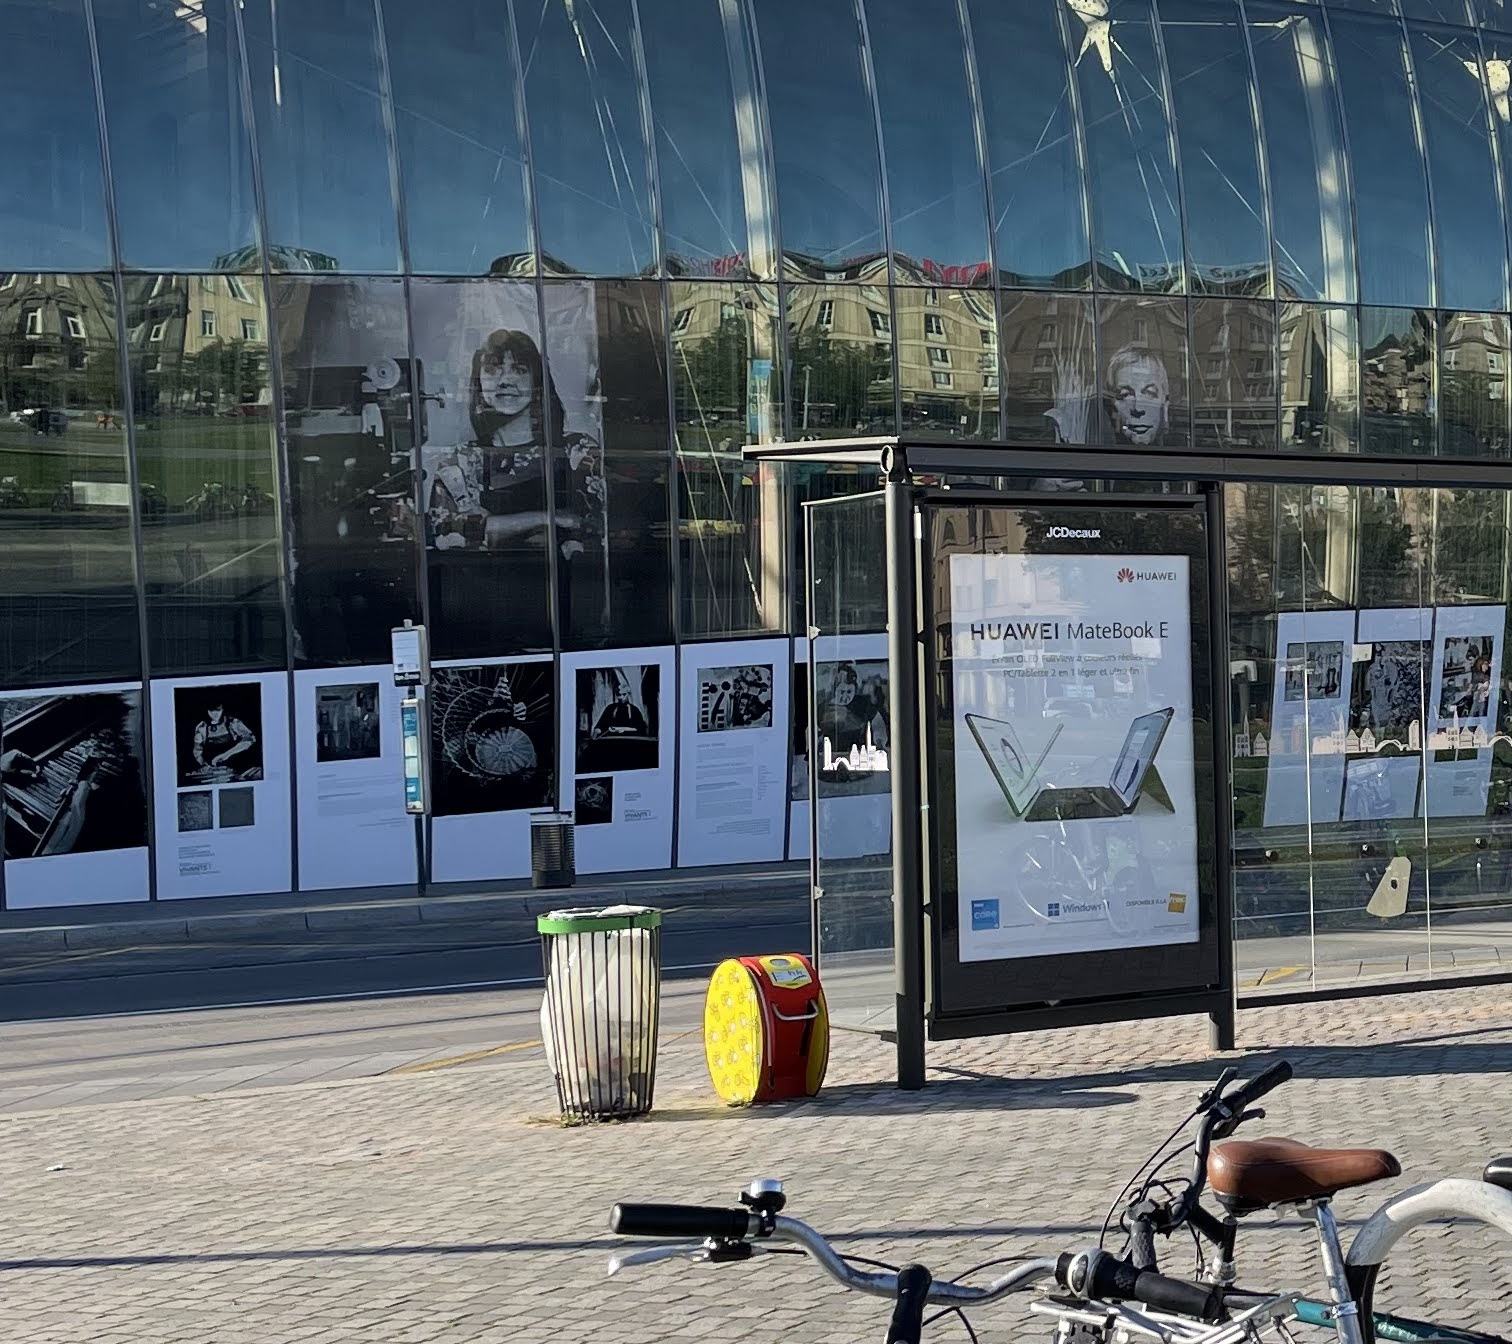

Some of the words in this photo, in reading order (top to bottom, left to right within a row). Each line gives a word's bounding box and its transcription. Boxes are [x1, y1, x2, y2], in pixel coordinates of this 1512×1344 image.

[1046, 526, 1101, 538] JCDecaux
[1136, 572, 1177, 581] HUAWEI
[970, 622, 1059, 641] HUAWEI
[1067, 620, 1155, 640] MateBook
[1159, 621, 1169, 638] E
[1051, 668, 1057, 677] 2
